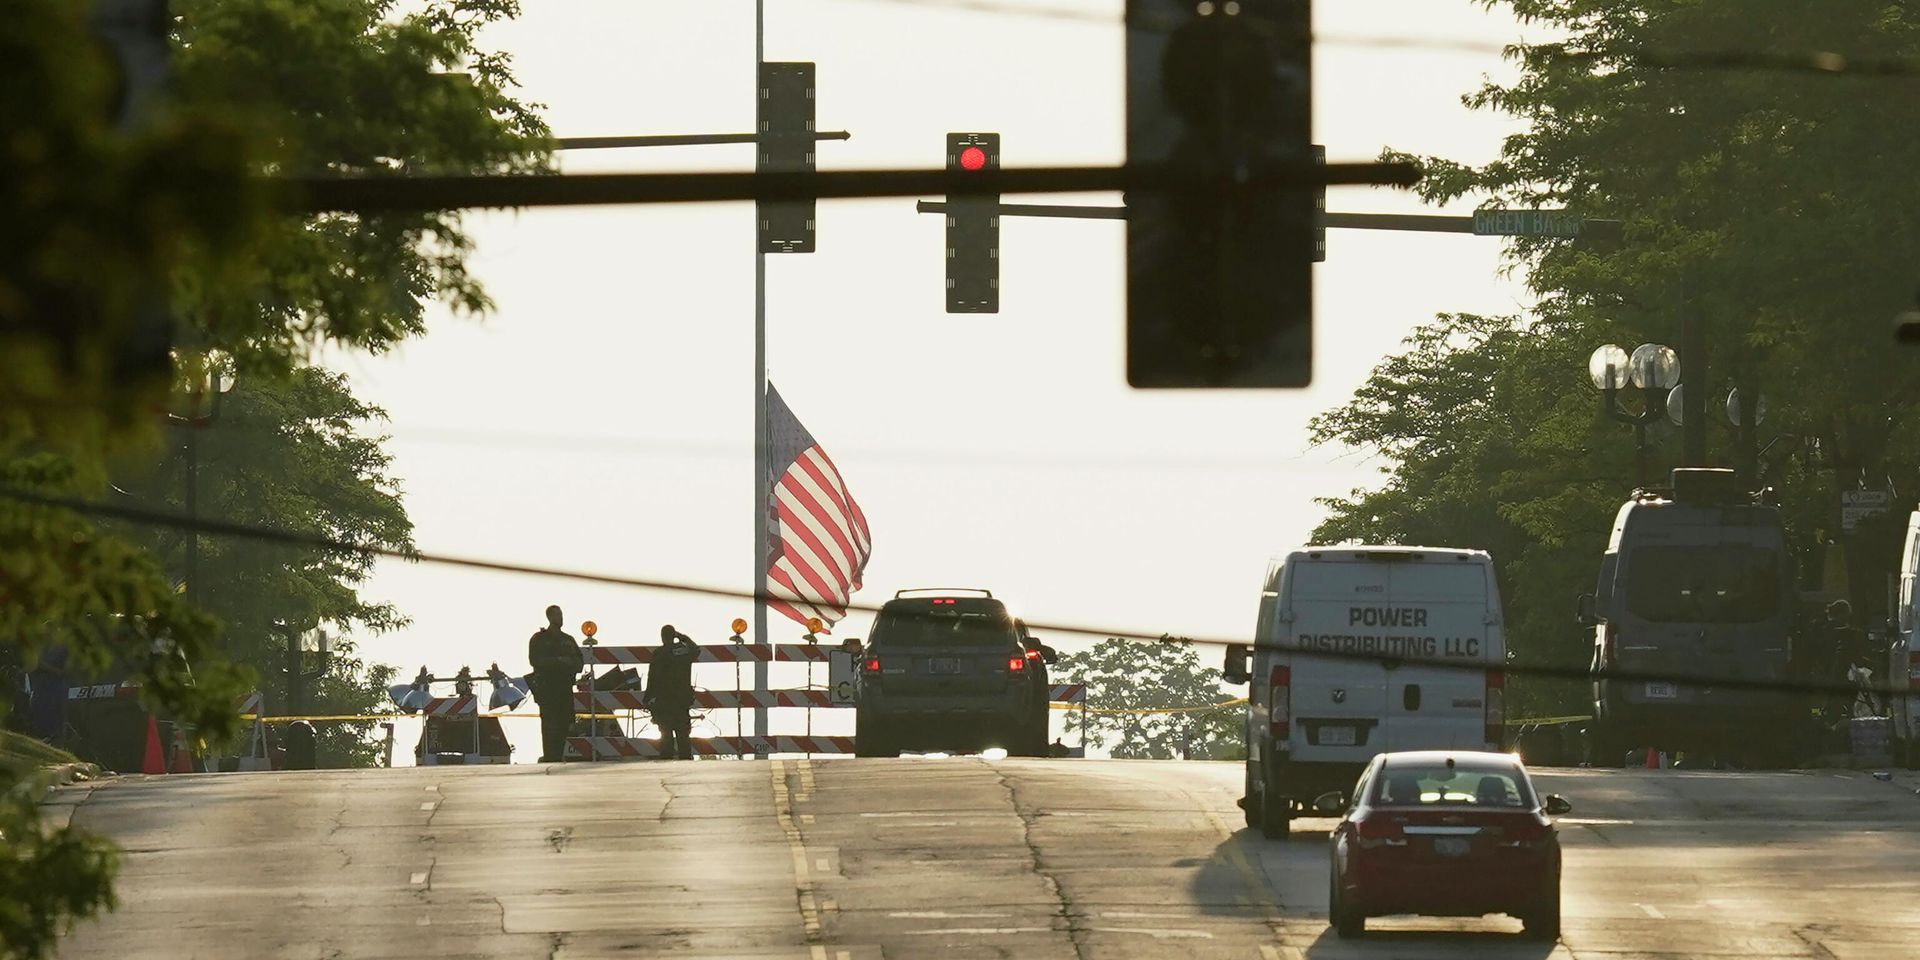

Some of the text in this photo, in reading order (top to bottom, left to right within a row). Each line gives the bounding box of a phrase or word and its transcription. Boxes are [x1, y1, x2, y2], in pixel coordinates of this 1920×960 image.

[1476, 211, 1524, 233] GREEN
[1349, 607, 1428, 627] POWER
[1299, 634, 1479, 657] DISTRIBUTING LLC
